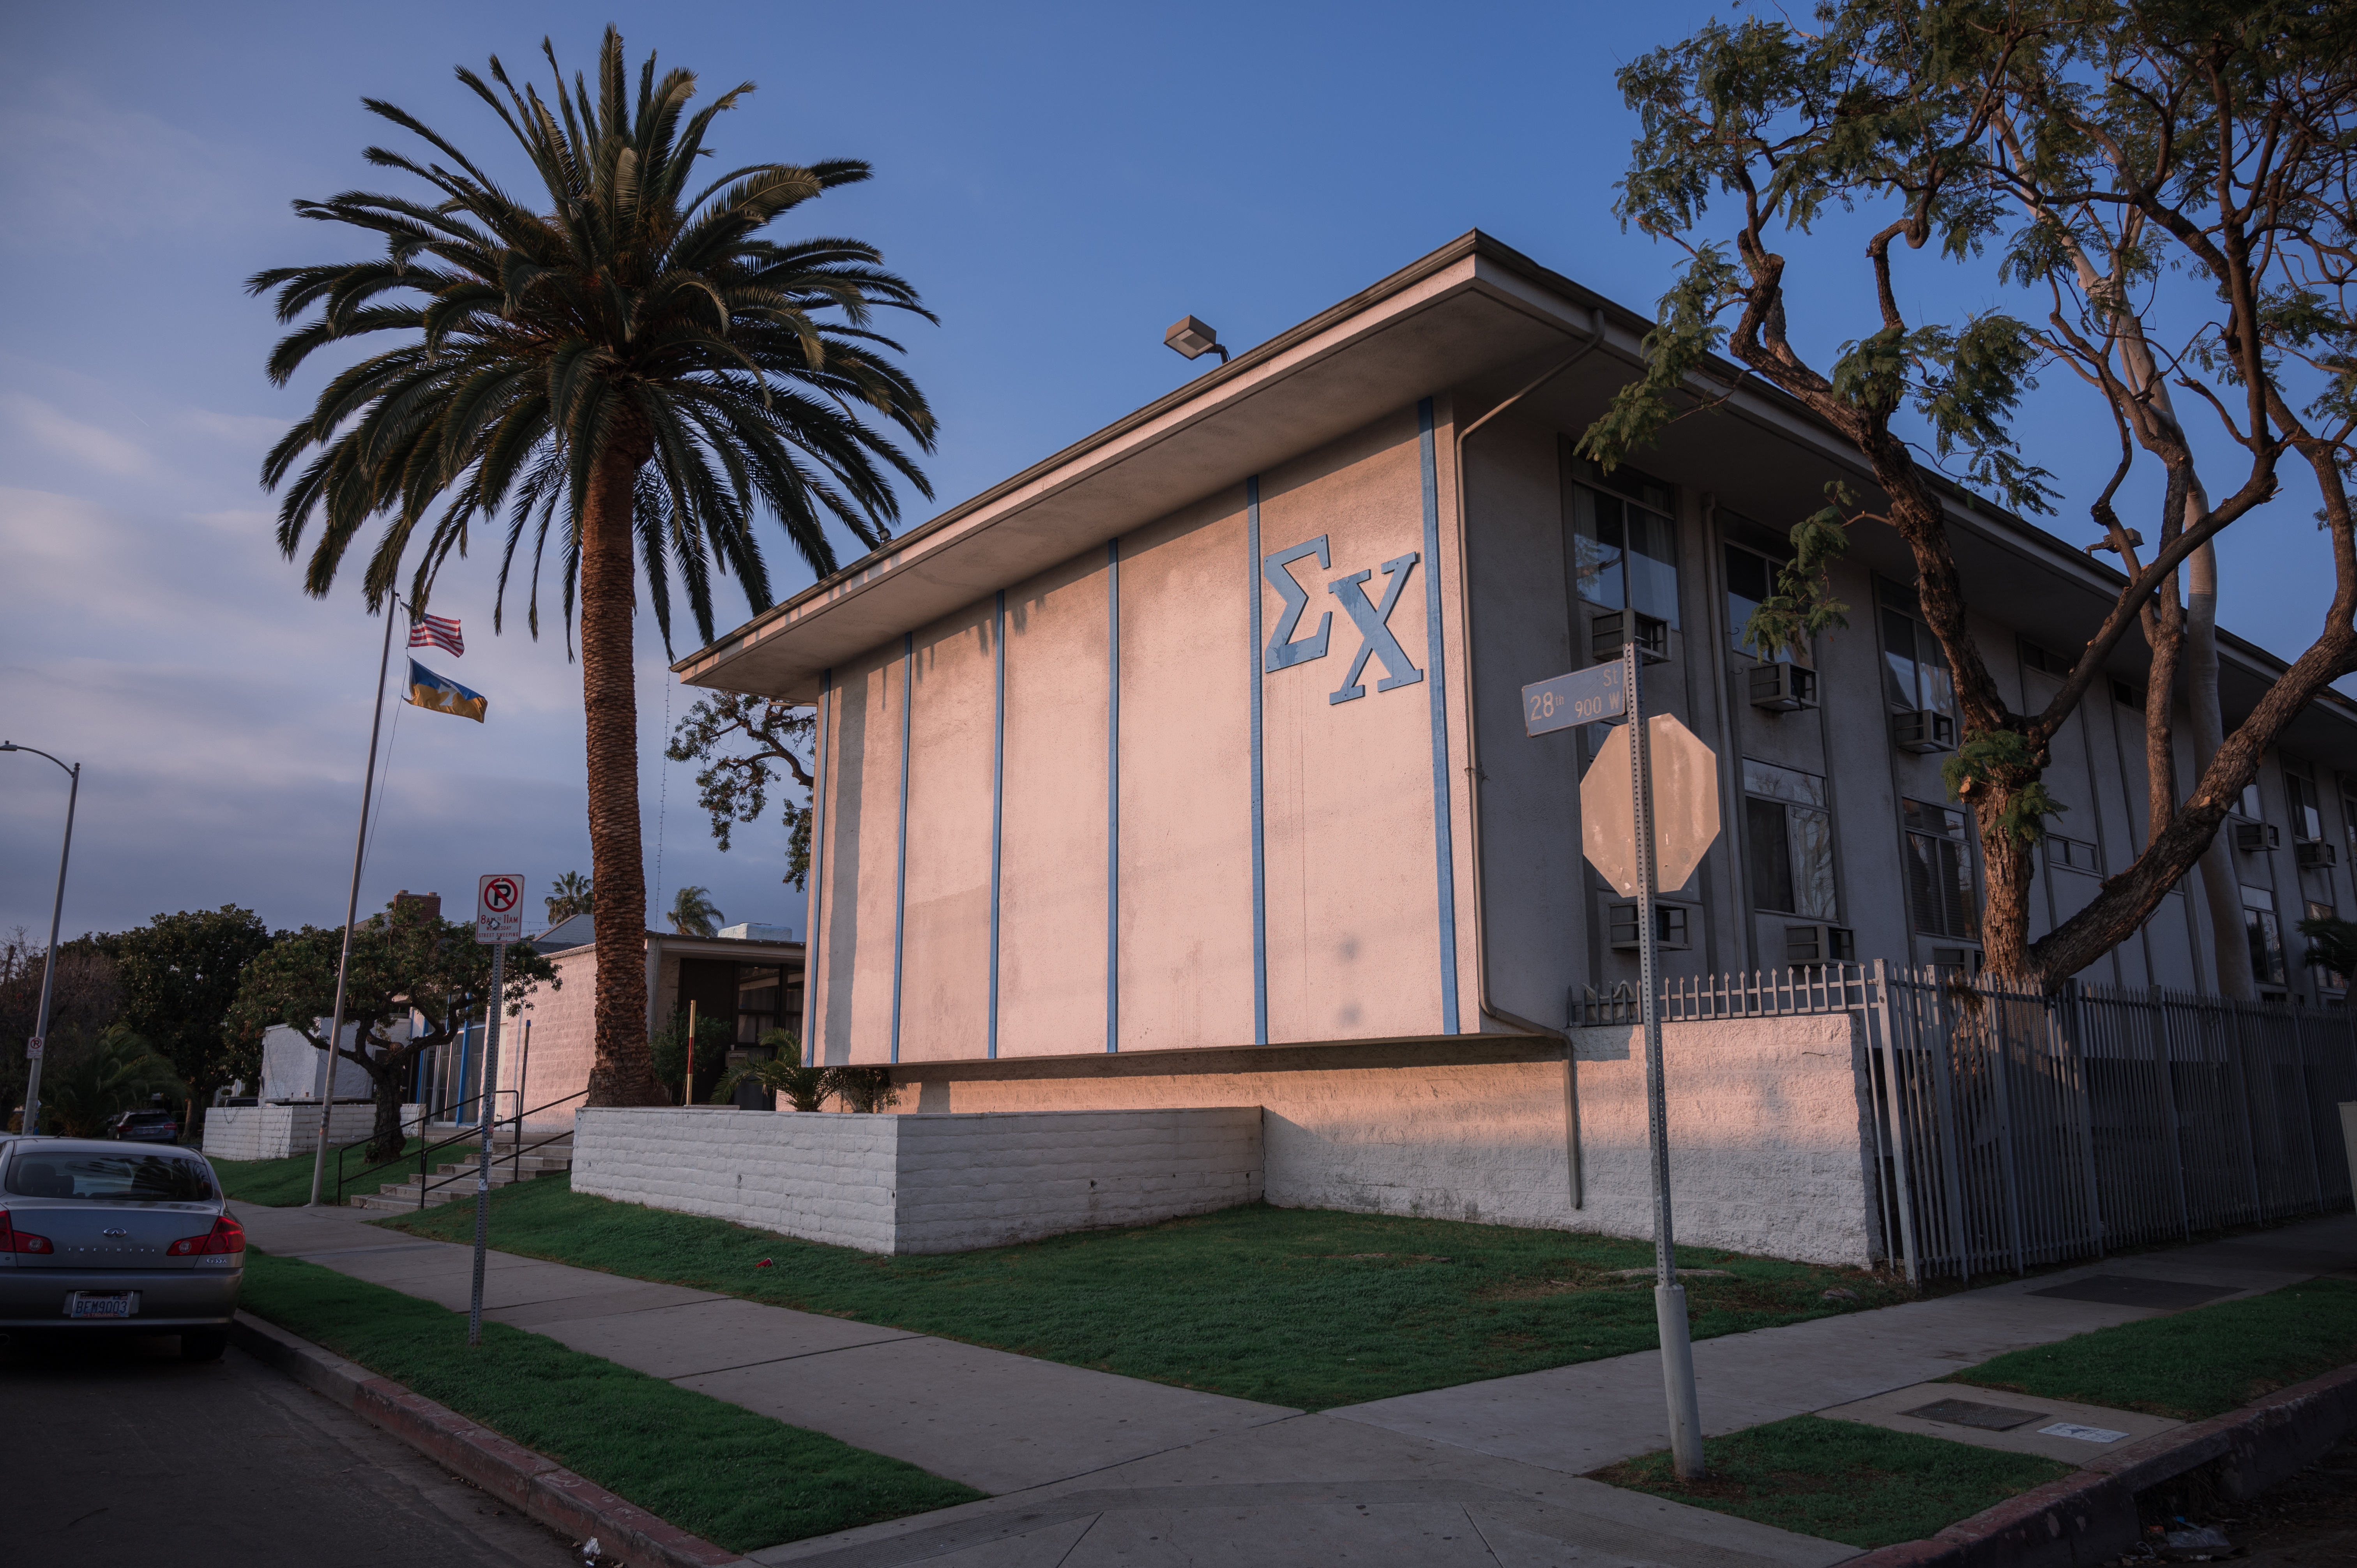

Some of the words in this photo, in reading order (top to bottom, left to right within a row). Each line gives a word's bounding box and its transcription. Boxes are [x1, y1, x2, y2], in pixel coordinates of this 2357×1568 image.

[1530, 691, 1564, 721] 28th
[1603, 667, 1618, 687] St
[1574, 696, 1602, 719] 900
[1608, 691, 1620, 710] W
[504, 914, 518, 923] 11AM
